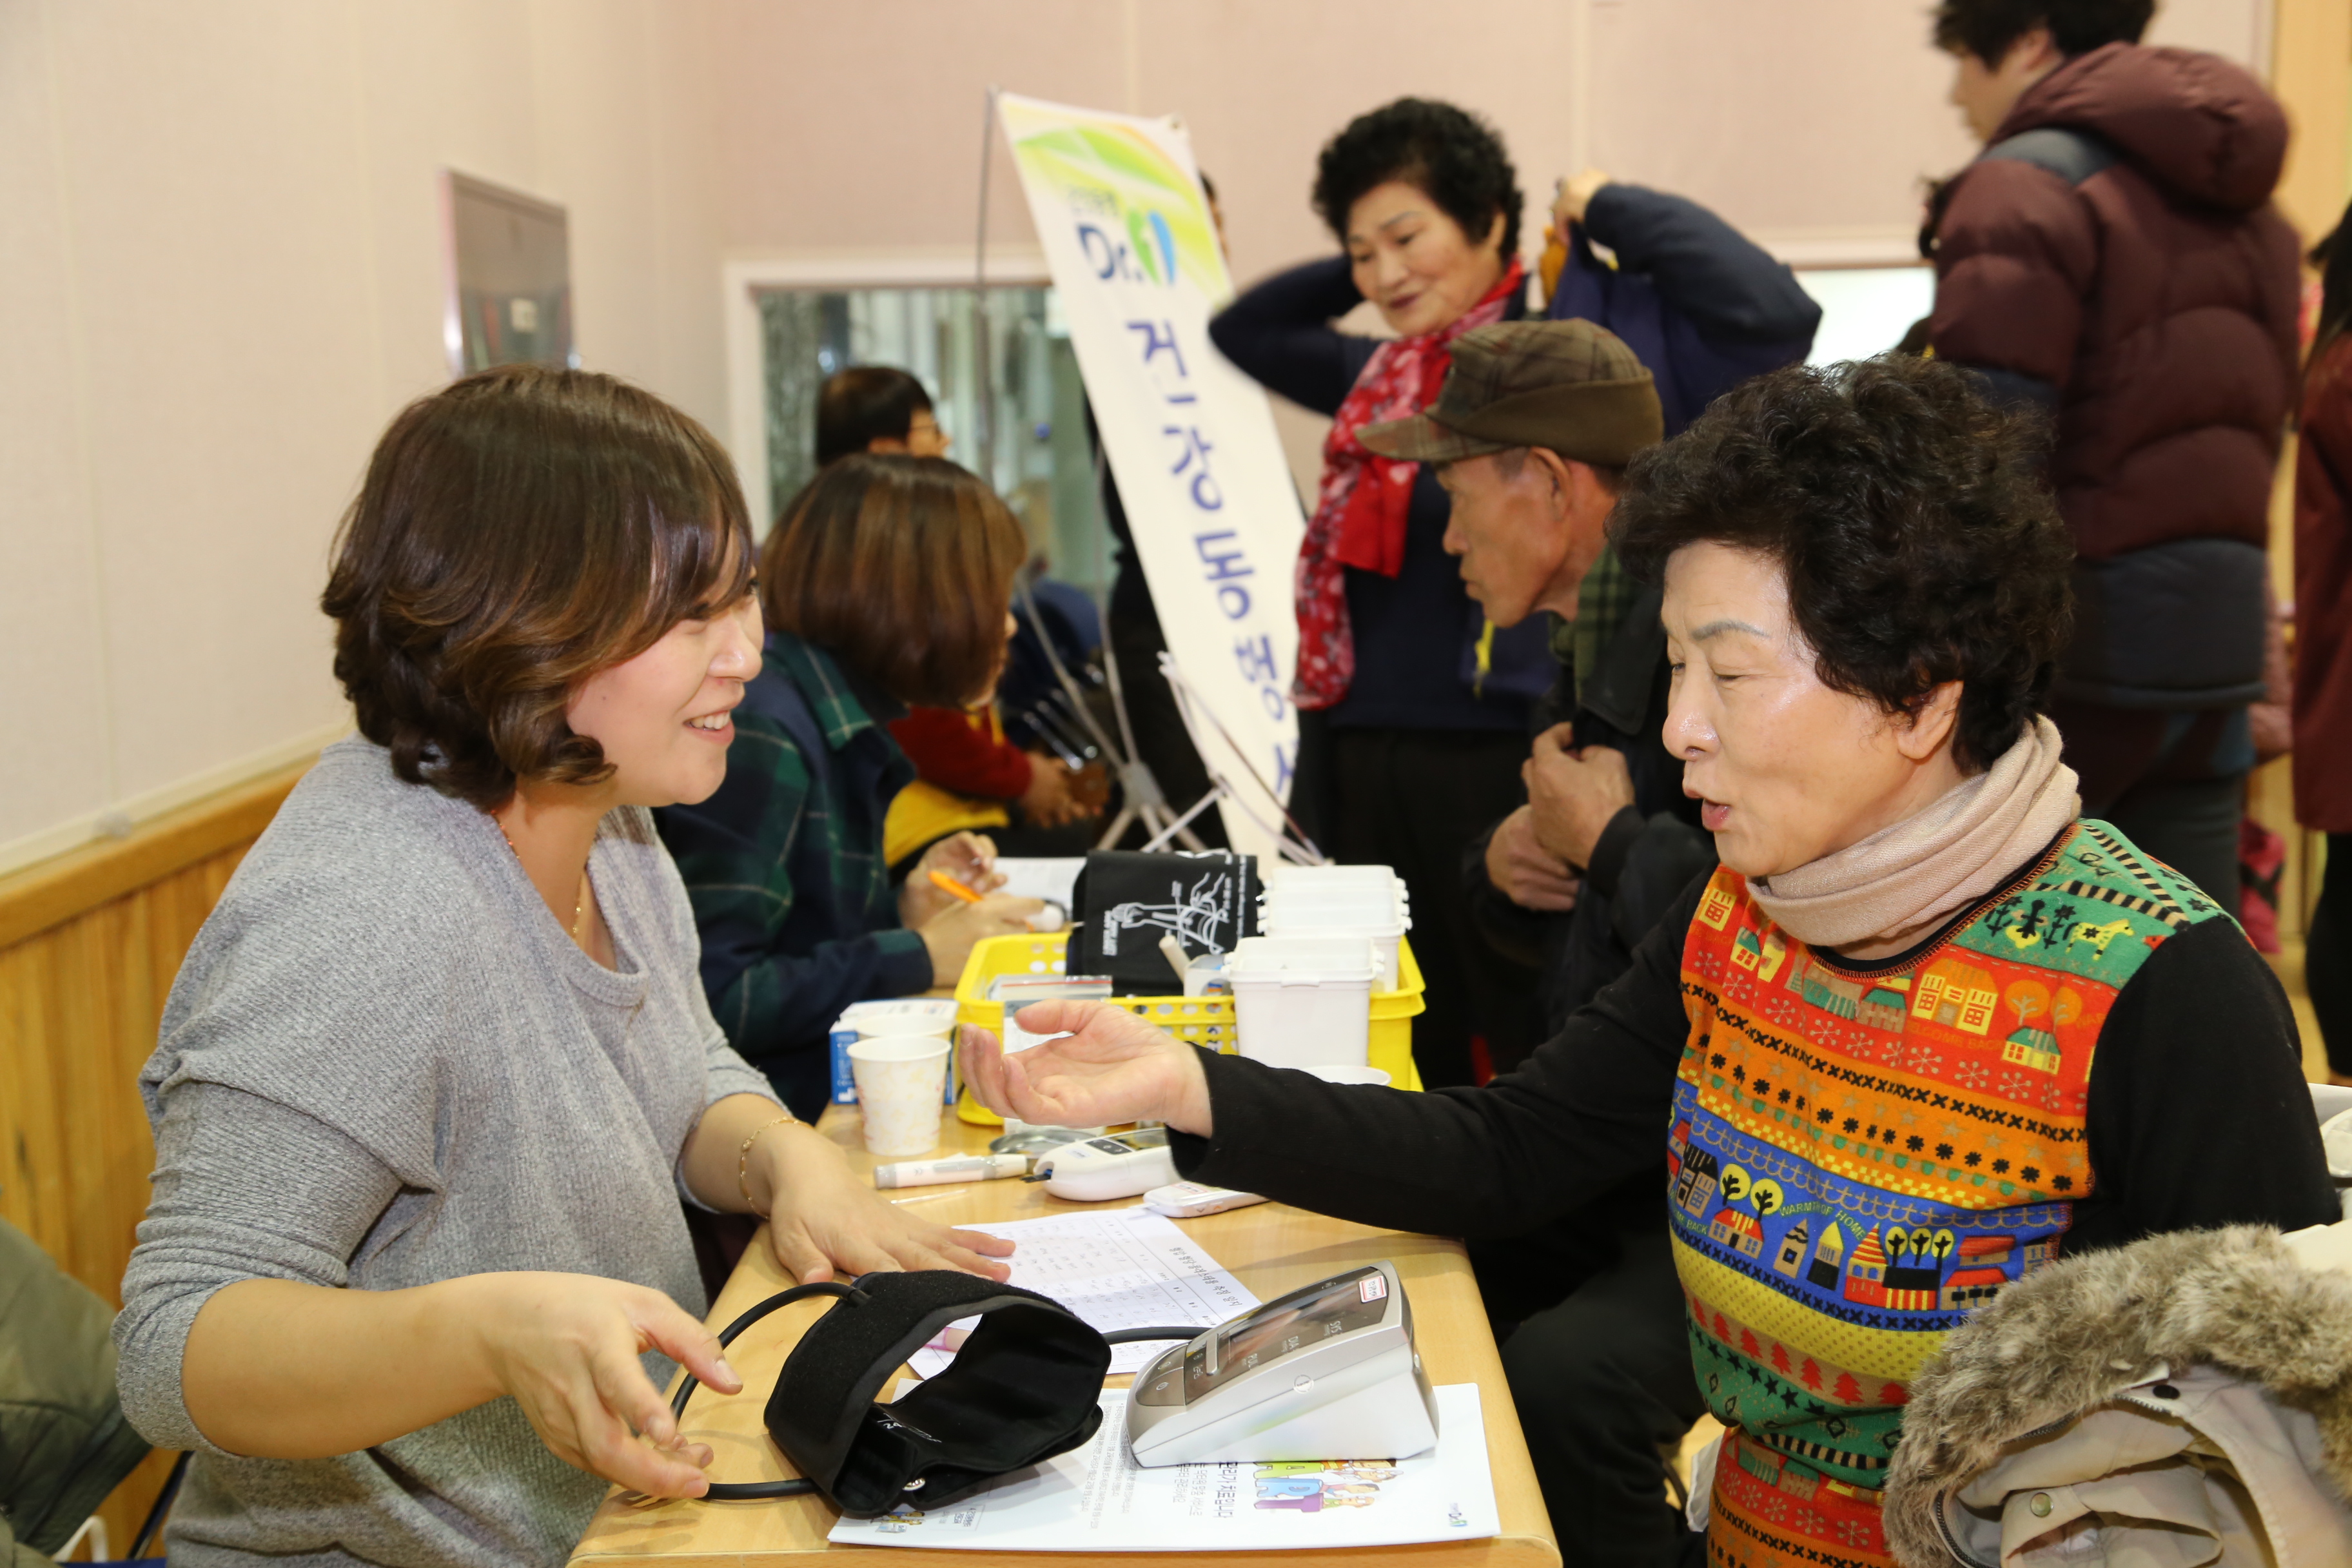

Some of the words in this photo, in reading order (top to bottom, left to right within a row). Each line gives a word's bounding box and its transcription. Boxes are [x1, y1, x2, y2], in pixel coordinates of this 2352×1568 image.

[1835, 1210, 1866, 1240] HOME
[1213, 1286, 1231, 1295] 측정
[1223, 1296, 1242, 1306] 일지
[1329, 1320, 1342, 1334] SYS
[1288, 1335, 1299, 1350] DIA
[1248, 1353, 1258, 1368] PUL
[1213, 1485, 1237, 1518] 치료입니다
